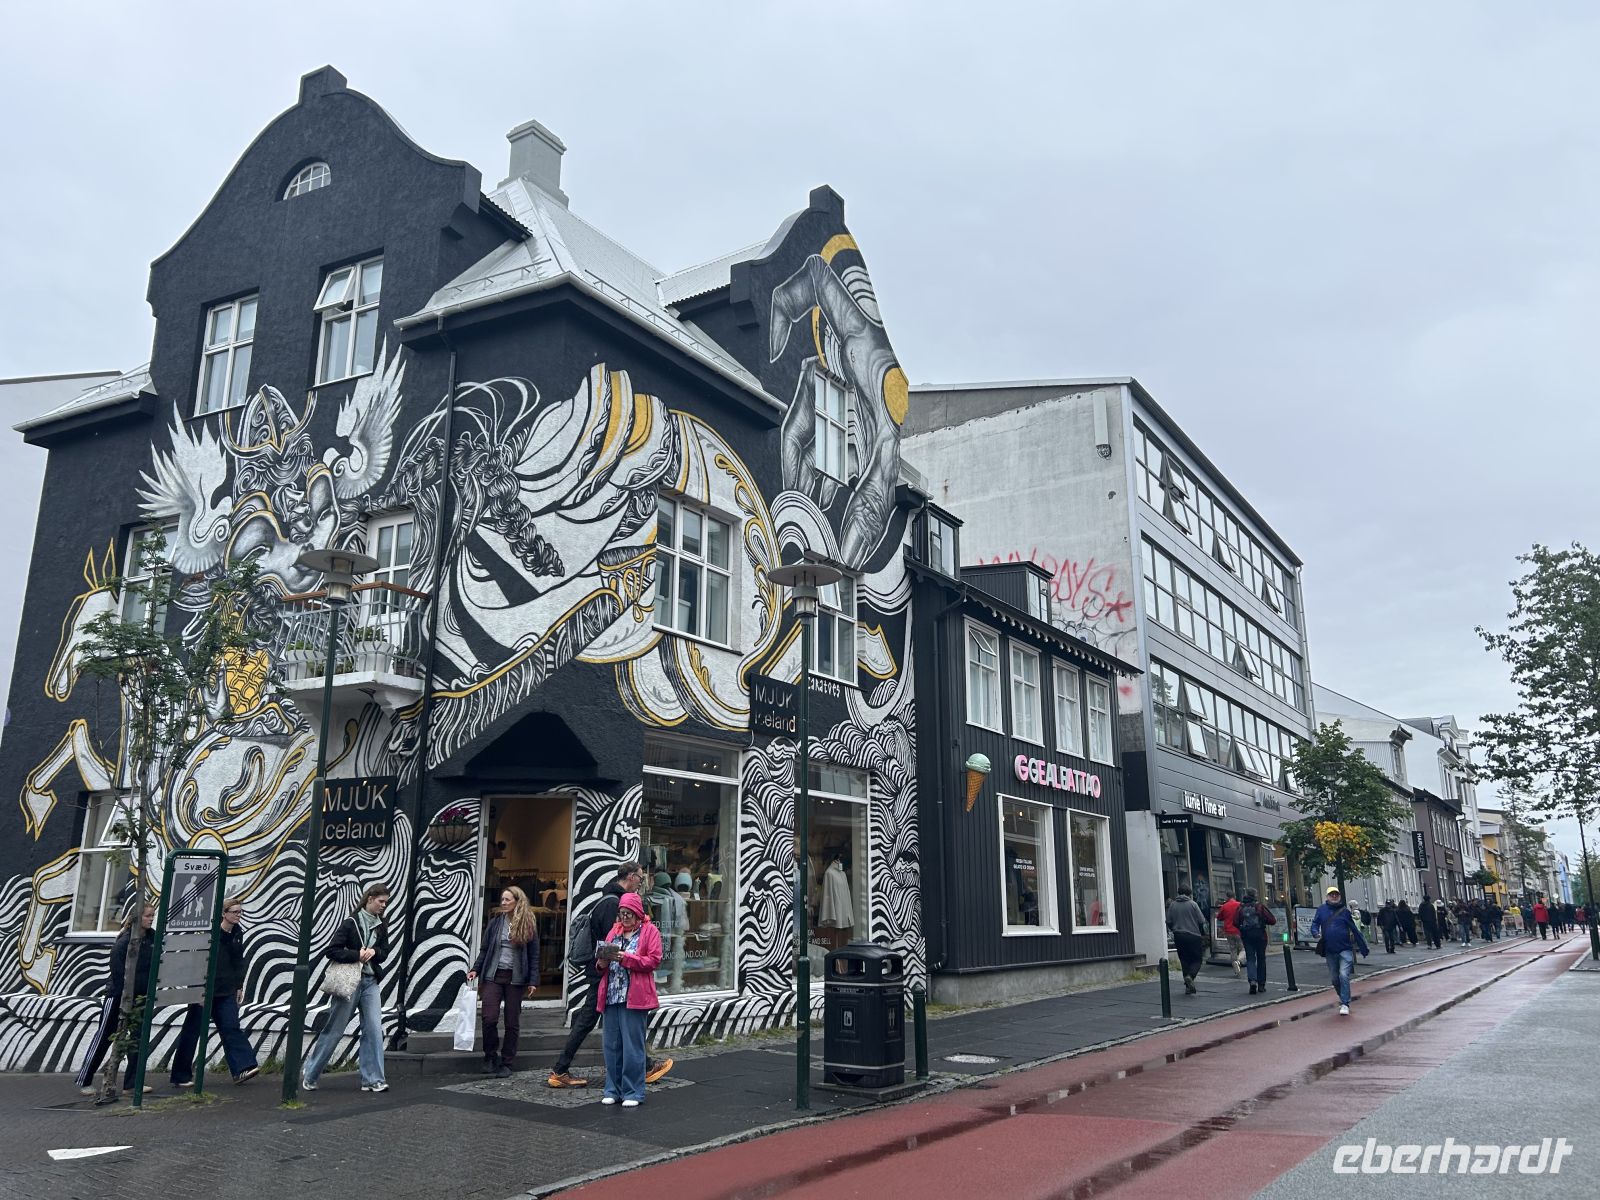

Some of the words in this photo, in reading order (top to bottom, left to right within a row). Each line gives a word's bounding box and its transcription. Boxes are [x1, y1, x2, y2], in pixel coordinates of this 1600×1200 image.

[322, 780, 389, 812] MJÚK
[320, 817, 386, 840] Iceland
[183, 862, 211, 871] Svæði
[170, 919, 208, 927] Göngugata
[821, 937, 832, 945] SELL
